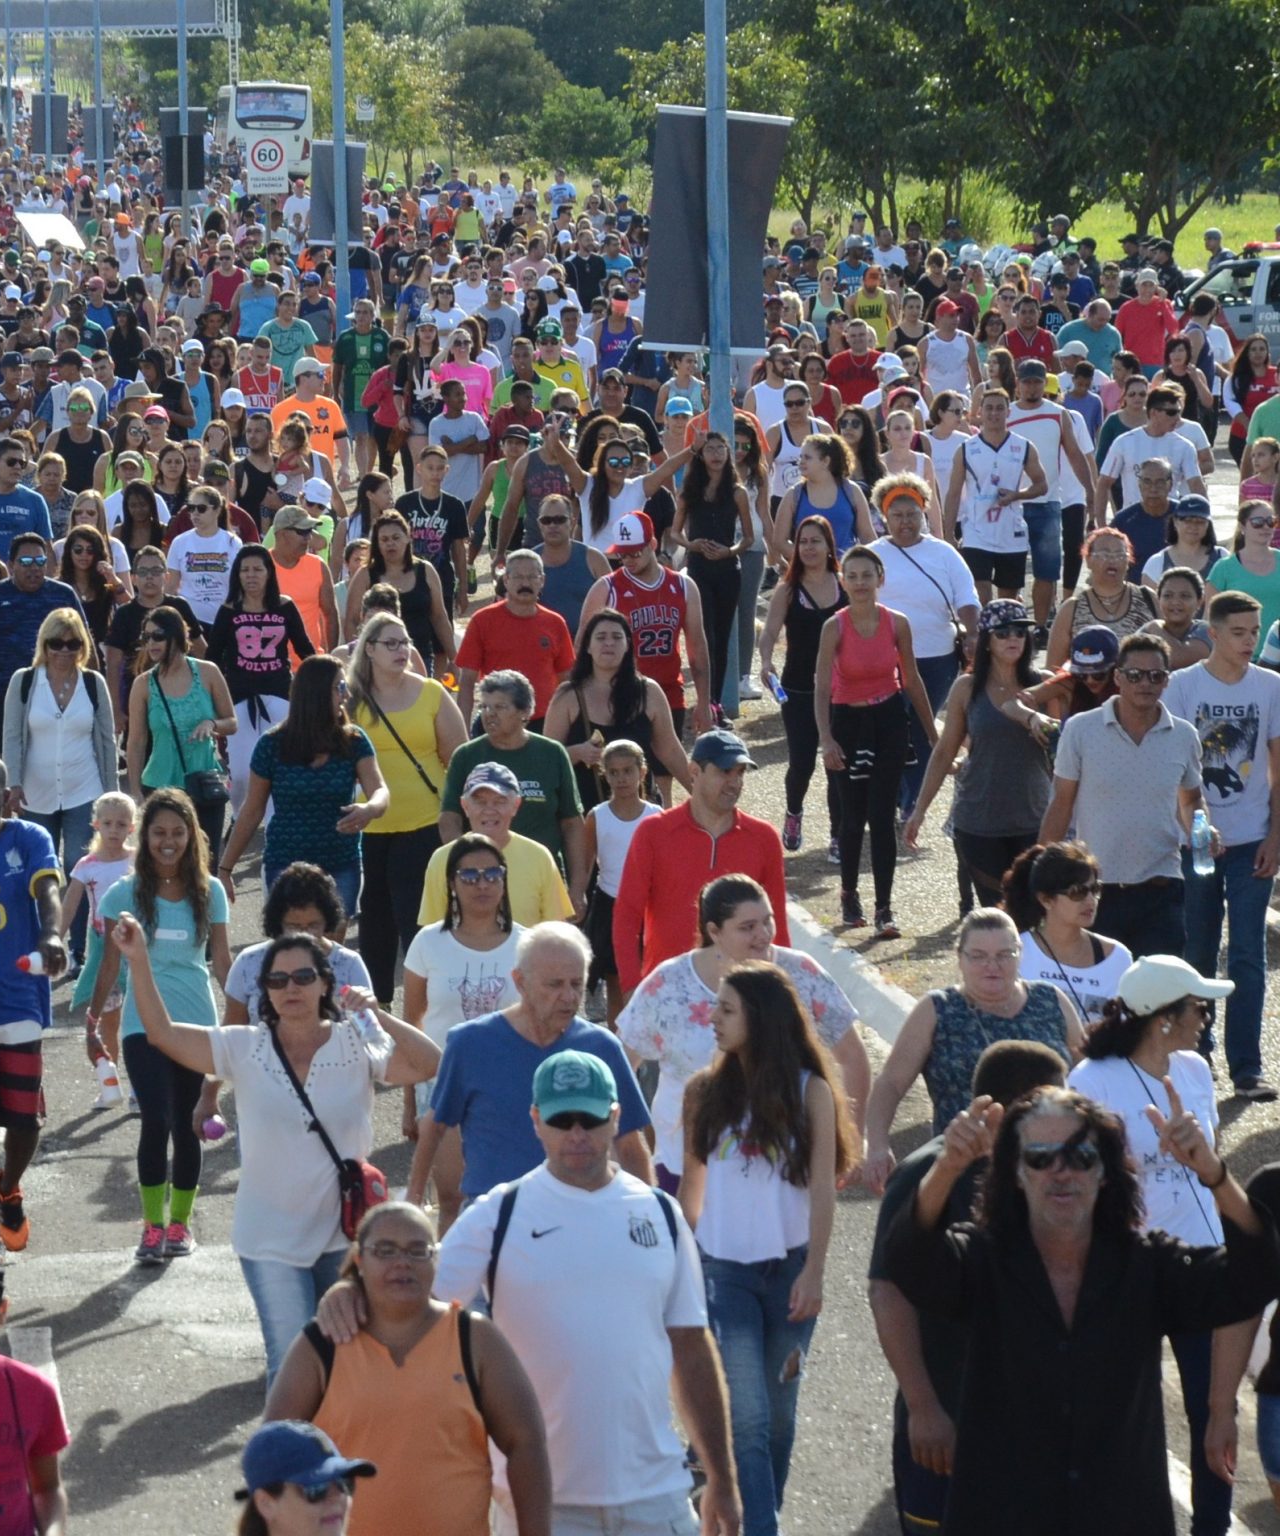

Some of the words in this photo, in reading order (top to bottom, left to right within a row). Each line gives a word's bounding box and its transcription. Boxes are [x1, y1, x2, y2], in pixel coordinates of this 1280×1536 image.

[257, 148, 278, 162] 60
[987, 505, 1000, 523] 17
[232, 613, 286, 625] CHICAGO
[630, 605, 680, 630] BULLS
[235, 625, 286, 659] 87
[638, 630, 673, 657] 23
[236, 657, 283, 672] WOLVES
[1212, 705, 1245, 717] BTG
[1072, 976, 1083, 984] OF
